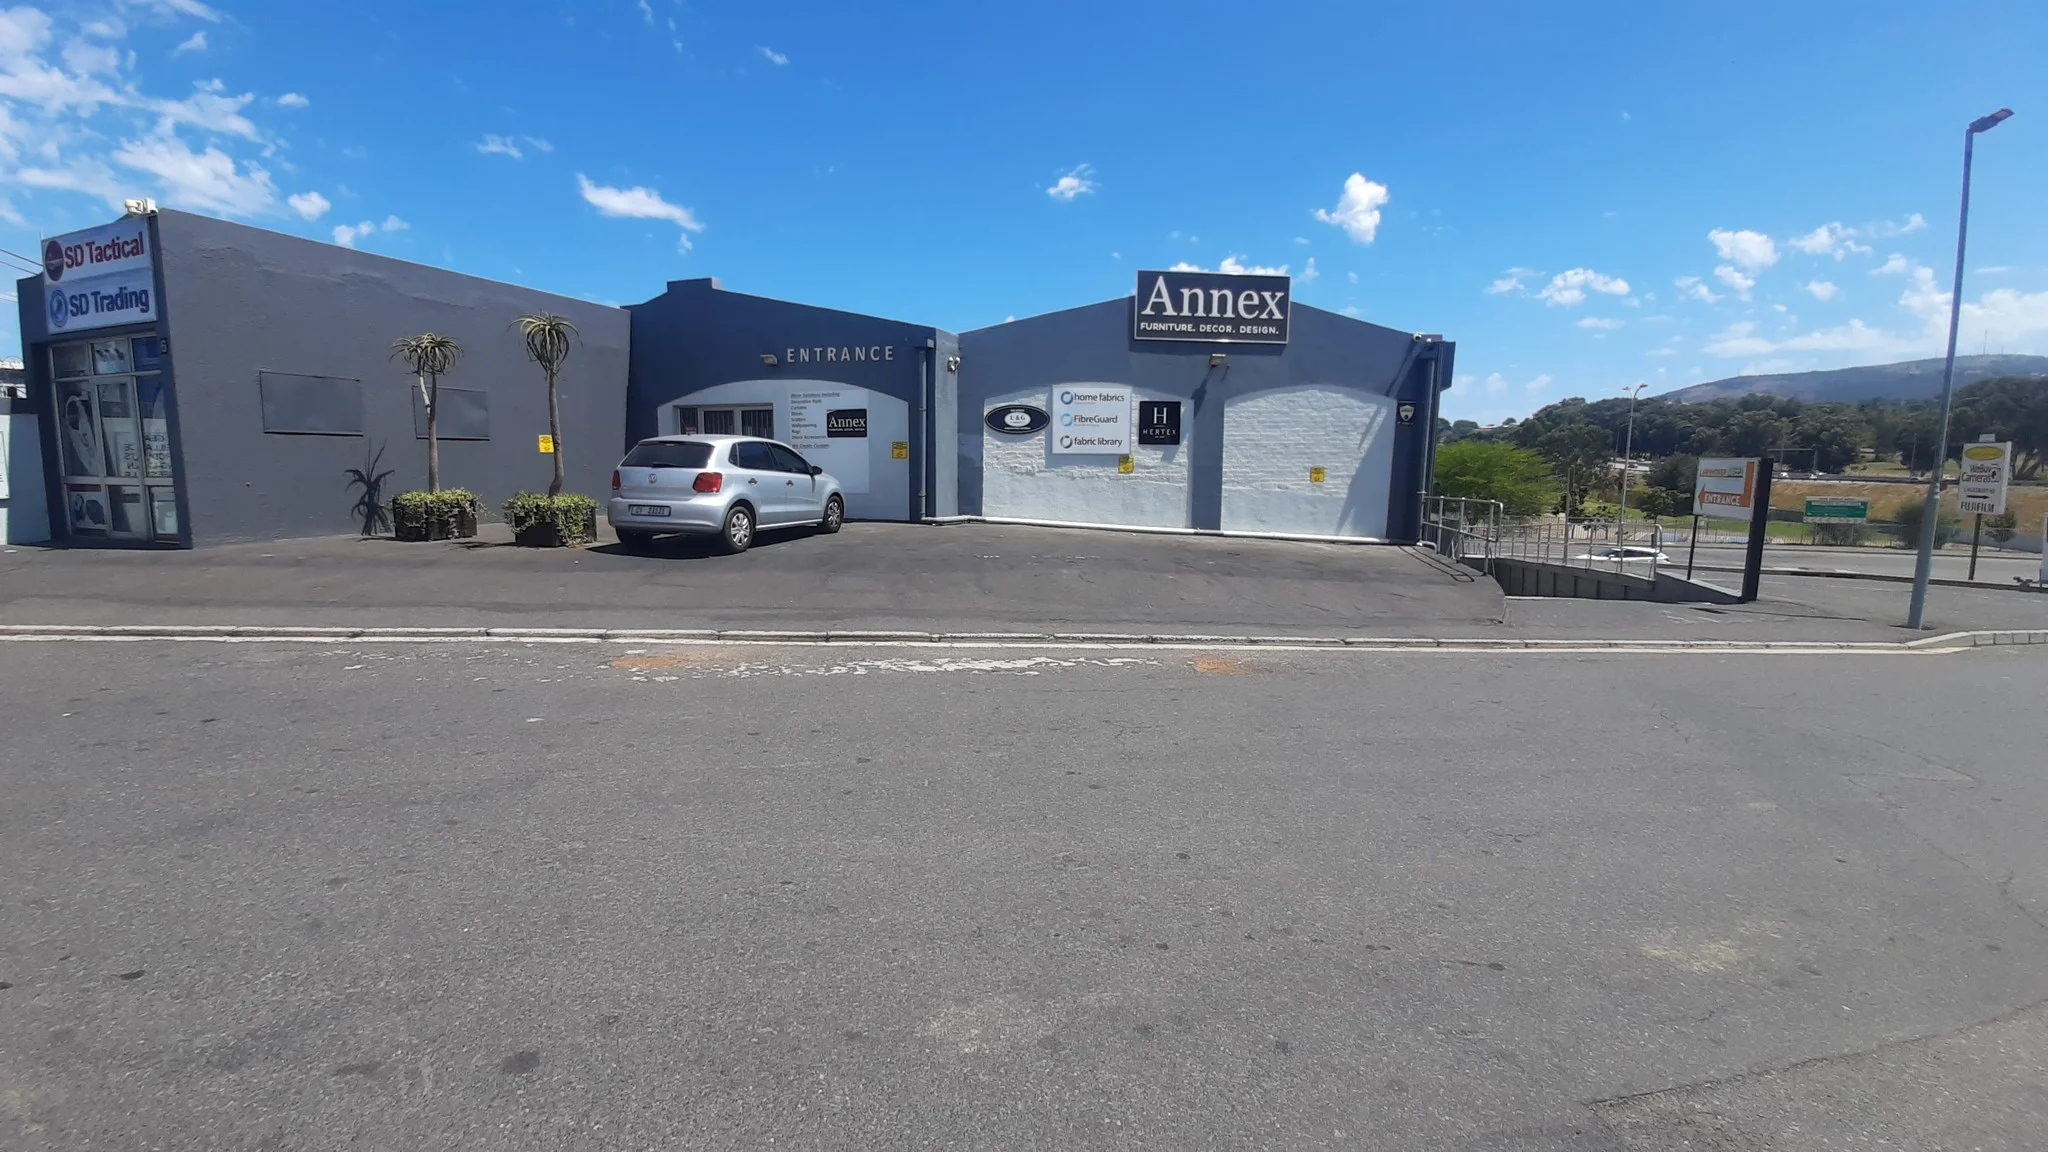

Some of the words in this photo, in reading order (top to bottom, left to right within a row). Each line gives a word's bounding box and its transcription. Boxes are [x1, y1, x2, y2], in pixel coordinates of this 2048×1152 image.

[64, 244, 84, 269] SD
[85, 231, 145, 264] Tactical
[70, 293, 90, 317] SD
[91, 286, 150, 314] Trading
[1140, 275, 1285, 320] Annex
[1140, 322, 1196, 333] FURNITURE.
[1199, 324, 1236, 334] DECOR.
[1239, 325, 1280, 335] DESIGN.
[787, 345, 894, 363] ENTRANCE
[1074, 393, 1098, 402] home
[1099, 392, 1125, 402] fabrics
[828, 415, 866, 428] Annex
[1074, 414, 1118, 424] FibreGuard
[1153, 407, 1168, 425] H
[1142, 428, 1177, 436] HERTEX
[1074, 436, 1097, 446] fabric
[1098, 436, 1123, 448] library
[1704, 493, 1740, 506] ENTRANCE
[1960, 501, 1995, 513] FUJIFILM
